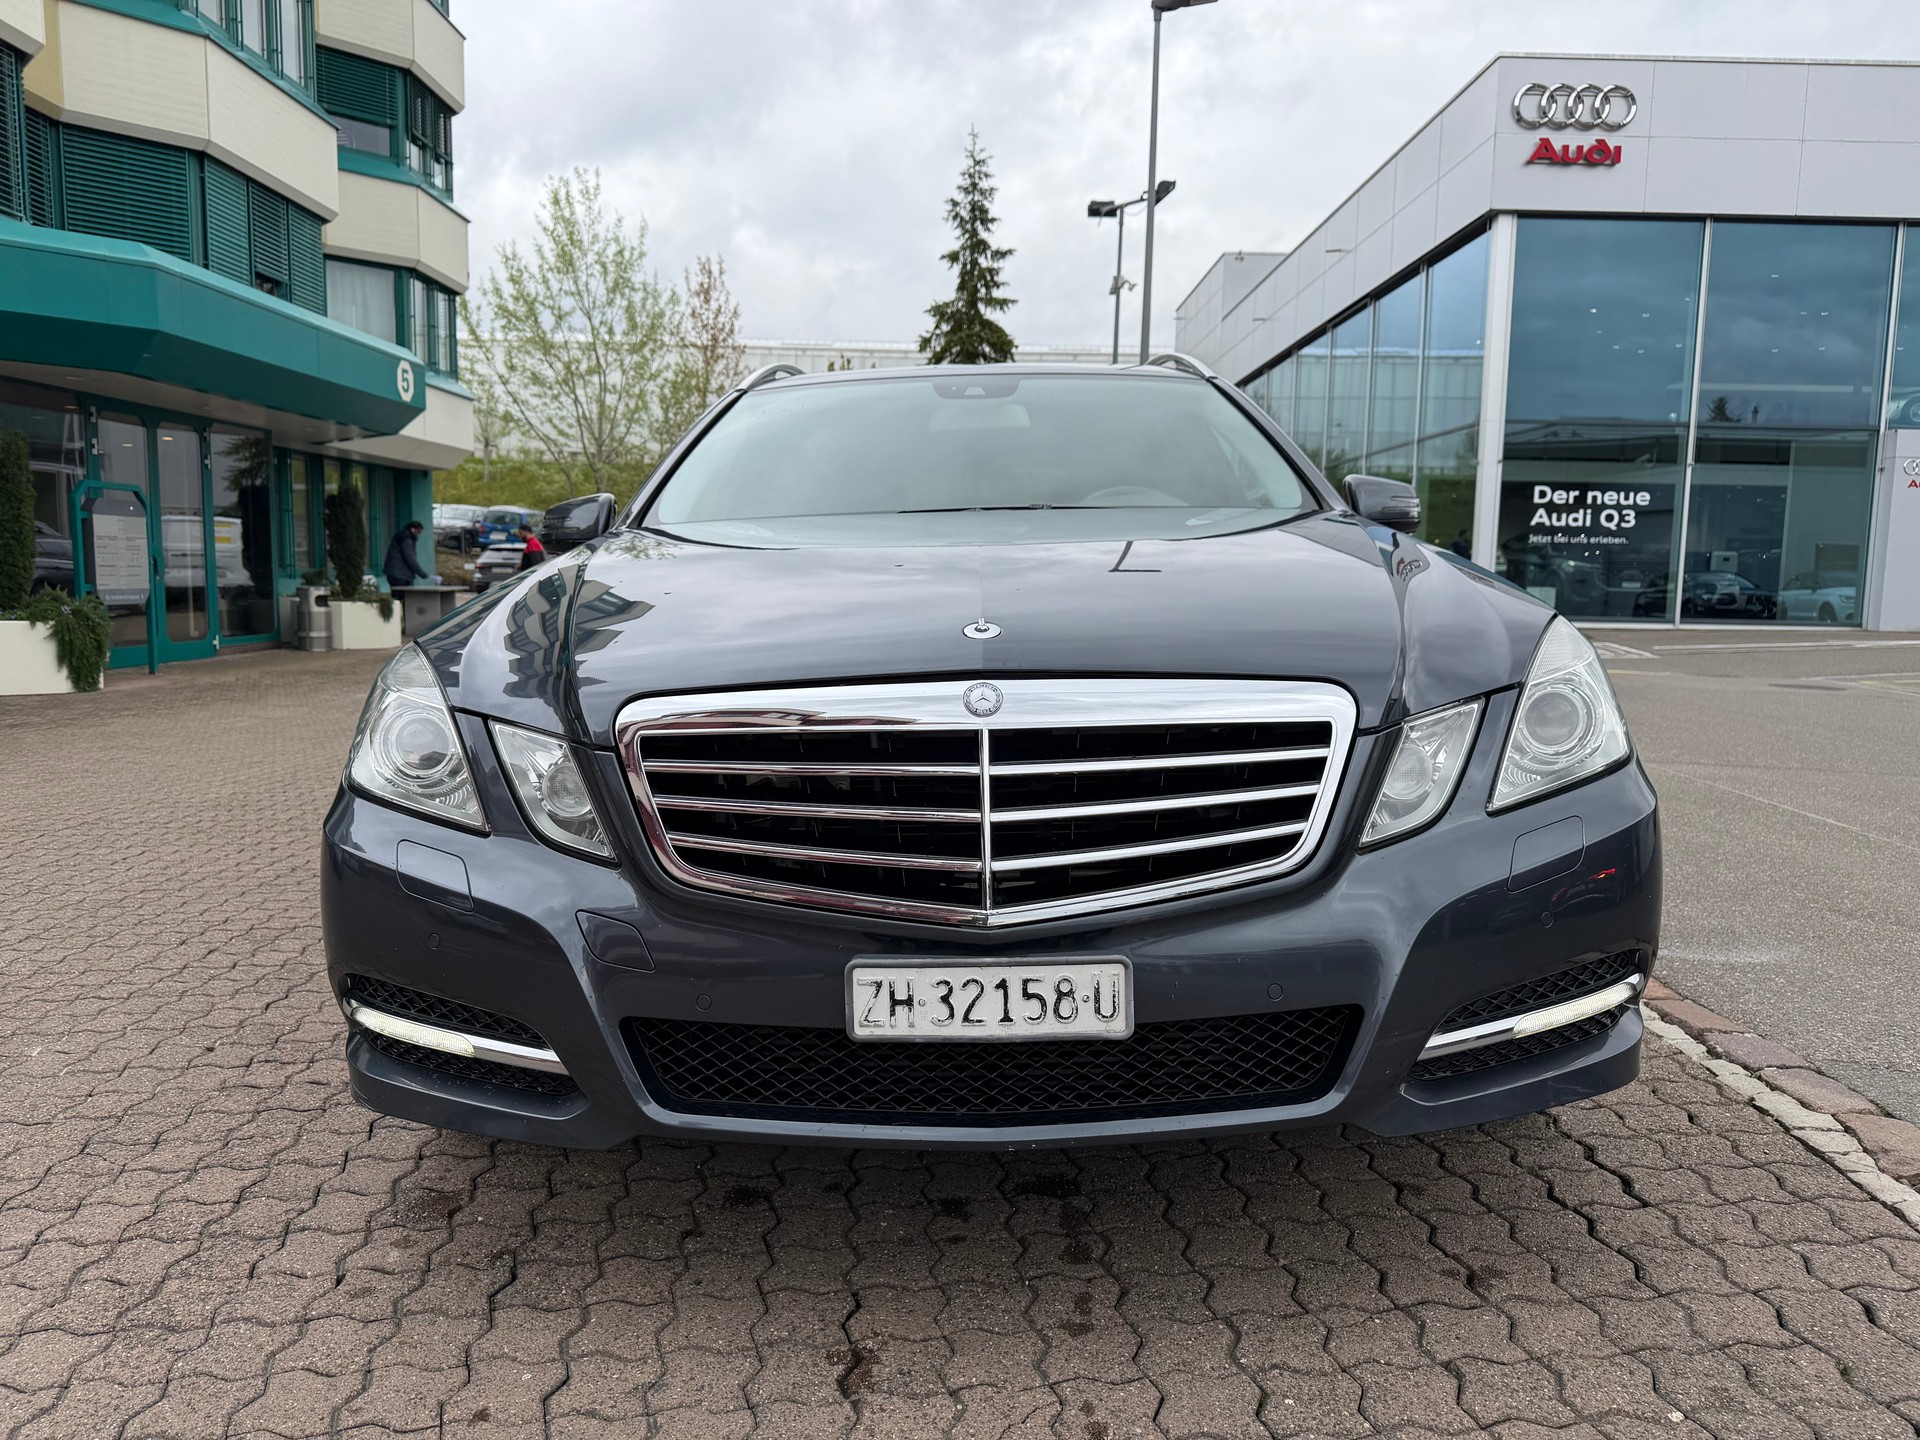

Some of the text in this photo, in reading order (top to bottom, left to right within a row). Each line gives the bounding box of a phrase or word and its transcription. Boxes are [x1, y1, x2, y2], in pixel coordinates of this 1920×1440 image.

[1527, 137, 1622, 165] Audi
[402, 368, 410, 393] 5
[1533, 485, 1651, 506] Der neue
[1530, 508, 1636, 530] Audi Q3
[1528, 533, 1629, 544] Jetzt bei uns erleben.
